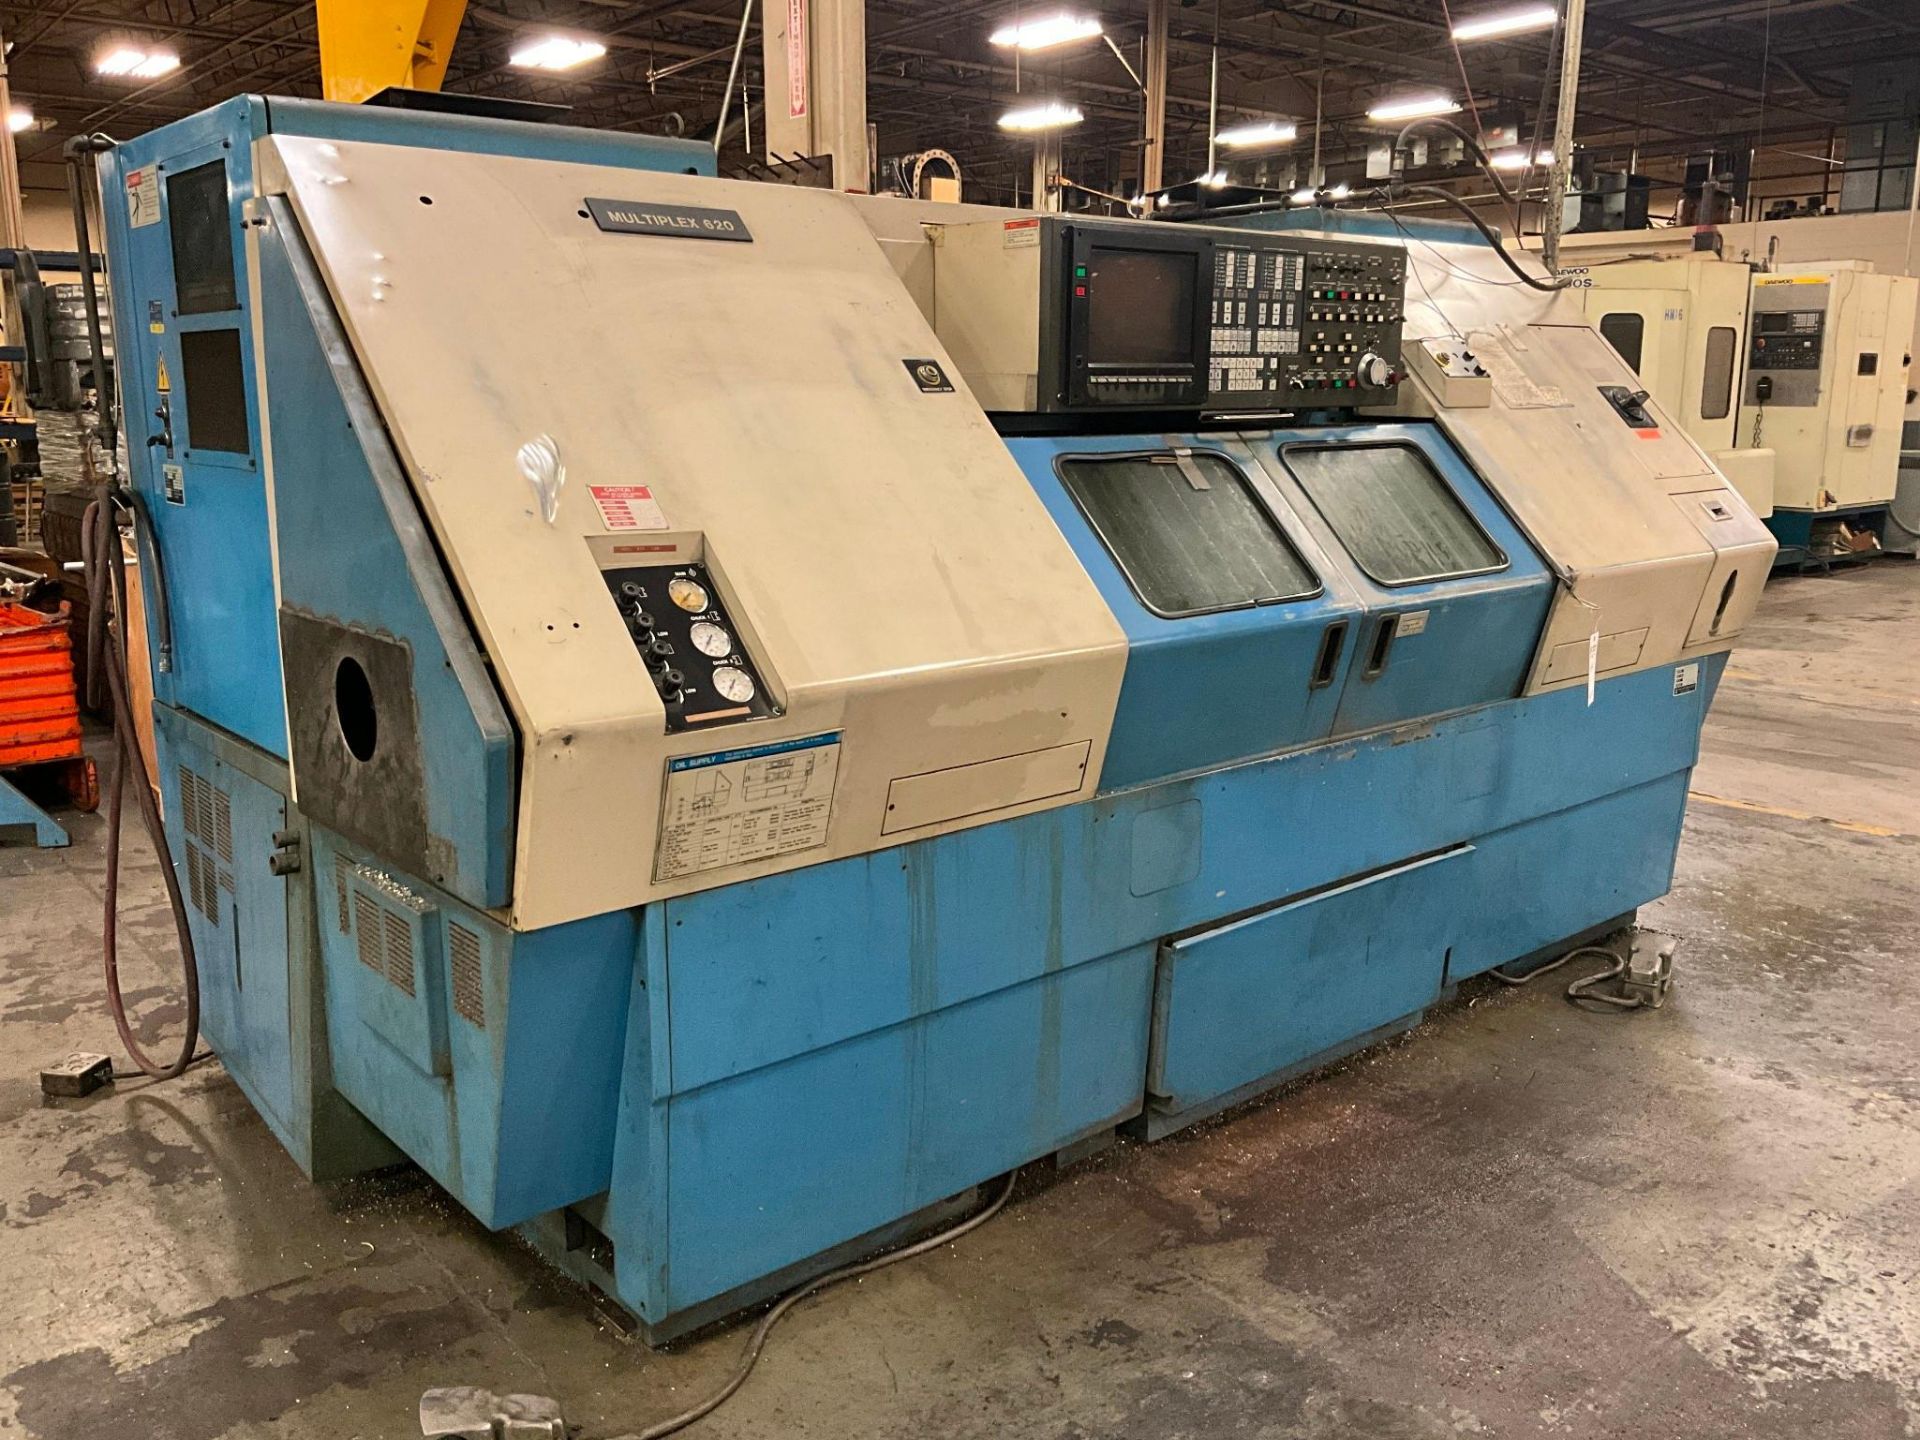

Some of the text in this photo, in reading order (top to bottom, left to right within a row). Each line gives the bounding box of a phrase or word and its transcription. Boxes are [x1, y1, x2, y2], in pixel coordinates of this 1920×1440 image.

[606, 210, 735, 231] MULTIPLEX 620
[675, 755, 716, 769] OIL SUPPLY
